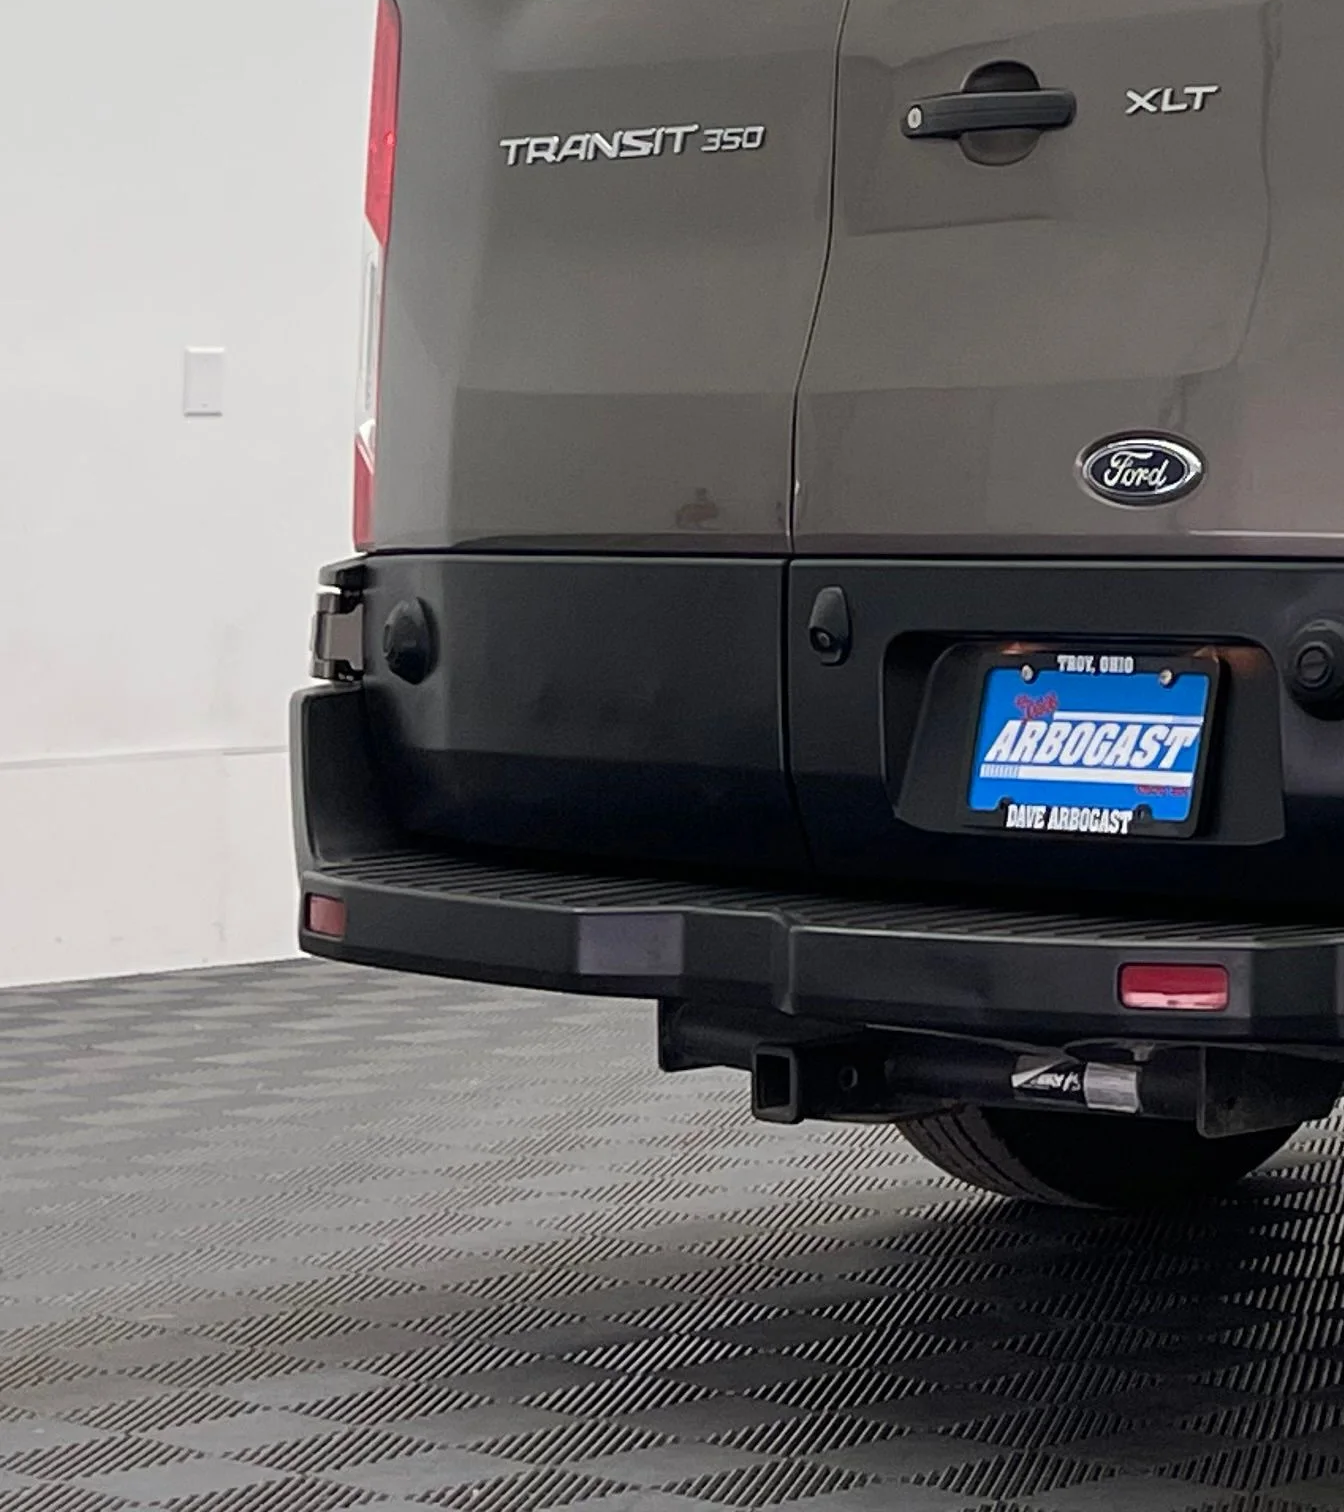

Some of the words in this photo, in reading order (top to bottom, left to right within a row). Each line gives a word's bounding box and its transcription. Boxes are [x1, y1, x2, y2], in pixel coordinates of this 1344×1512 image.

[1125, 85, 1220, 116] XLT
[500, 124, 700, 166] TRANSIT
[701, 126, 766, 152] 350
[1104, 450, 1170, 487] Ford
[1099, 656, 1135, 674] OHIO
[983, 719, 1201, 769] ARBOGAST
[1006, 803, 1047, 830] DAVE
[1047, 805, 1134, 834] ARBOGAST
